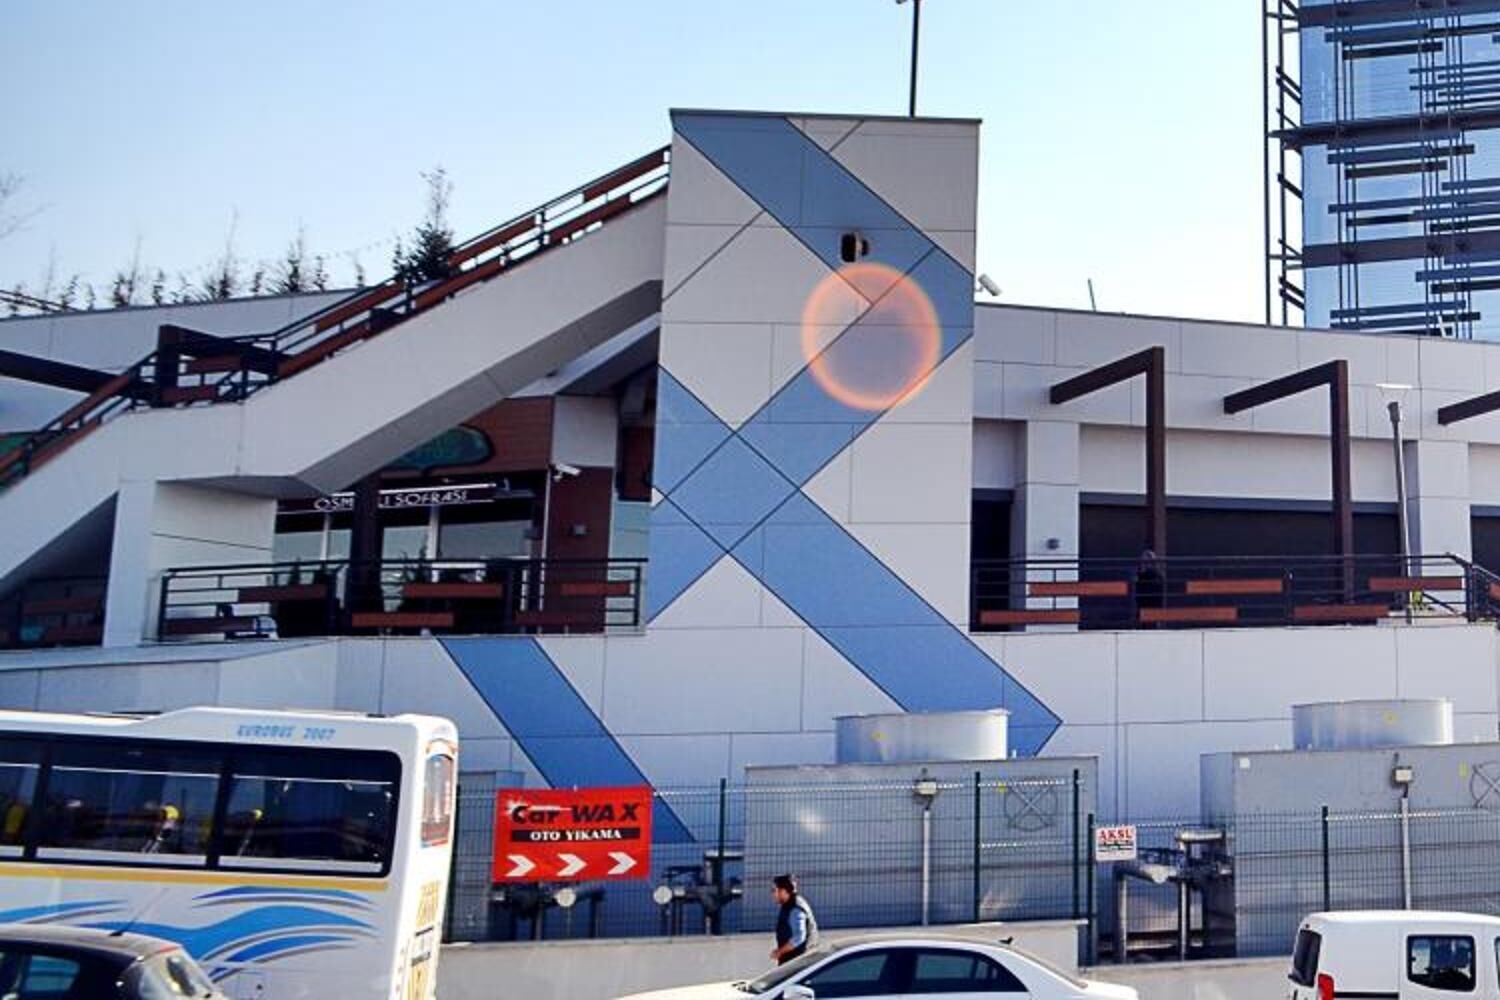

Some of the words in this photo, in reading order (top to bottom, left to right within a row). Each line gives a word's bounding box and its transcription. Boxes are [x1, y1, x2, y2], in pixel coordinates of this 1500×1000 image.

[511, 805, 561, 824] Car
[571, 802, 639, 822] WAX
[529, 831, 561, 841] OTO
[565, 829, 622, 841] YIKAMA
